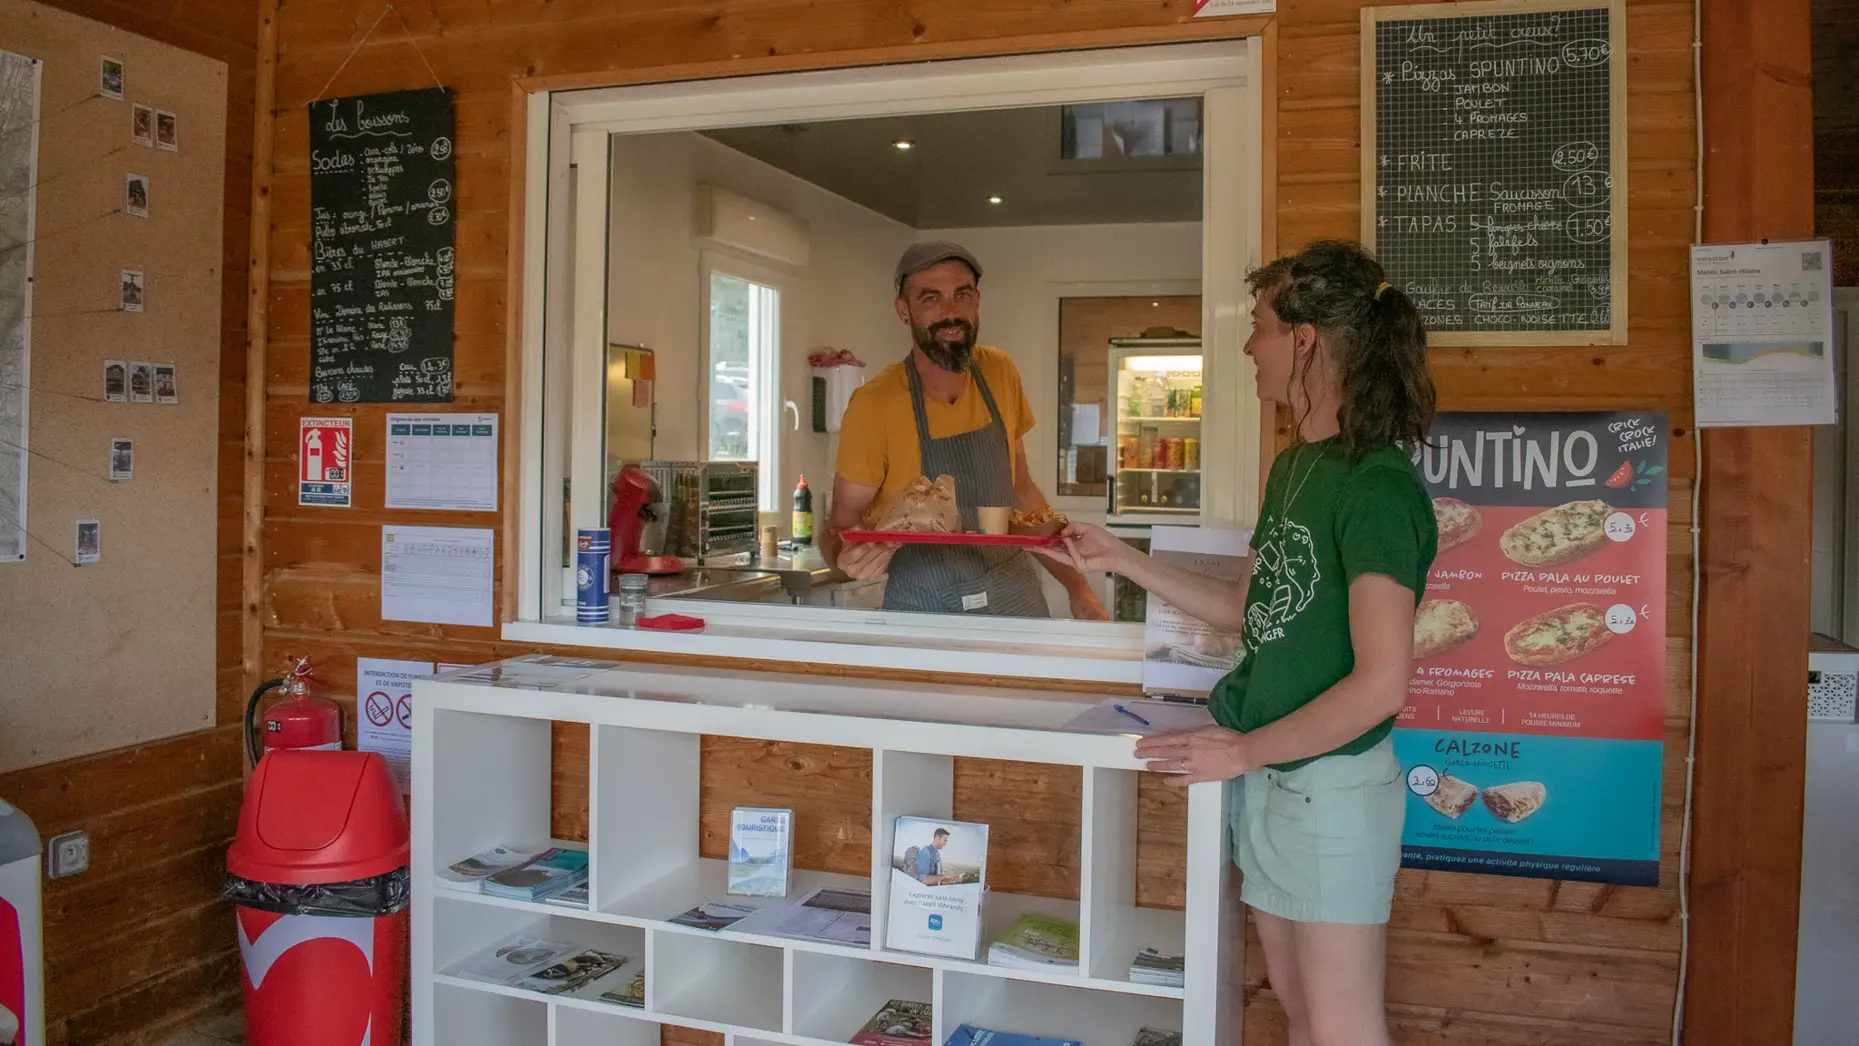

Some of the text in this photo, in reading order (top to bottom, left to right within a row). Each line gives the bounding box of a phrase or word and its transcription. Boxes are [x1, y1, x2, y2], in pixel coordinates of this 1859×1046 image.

[1406, 15, 1561, 64] Un petit creux?
[1402, 60, 1457, 92] Pizzas
[1454, 82, 1511, 95] JAMBON
[1456, 98, 1507, 110] POULET
[1454, 112, 1528, 124] 4 FROMAGES
[1454, 128, 1520, 141] CAPREZE
[312, 150, 355, 171] Sodas
[1397, 183, 1483, 203] PLANCHE
[1489, 182, 1564, 201] Saucisson
[1494, 201, 1555, 213] FROMAGE
[1394, 215, 1457, 233] TAPAS
[1470, 237, 1481, 255] 5
[1471, 255, 1482, 271] 5
[1412, 299, 1456, 311] LACES
[1421, 314, 1463, 325] ZONES
[302, 419, 351, 428] EXTINCTEUR
[1608, 418, 1641, 433] CRICK
[1619, 426, 1656, 442] CROCK
[1618, 436, 1657, 453] ITALIE!
[1411, 425, 1599, 490] UNTINO
[1434, 570, 1482, 580] JAMBON
[1502, 571, 1641, 585] PIZZA PALA AU POULET
[1425, 582, 1451, 591] zzarella
[1523, 584, 1617, 596] Poulet, pesto, mozzarella
[1416, 667, 1495, 680] 4 FROMAGES
[1507, 670, 1637, 686] PIZZA PALA CAPRESE
[391, 681, 412, 689] VAPOTE
[1408, 678, 1483, 691] damer, Gorgonzola
[1516, 682, 1624, 696] Mozzarella, tomate, roquette
[1422, 688, 1455, 697] Romano
[1459, 708, 1485, 717] LEVURE
[1537, 712, 1564, 721] HEURES
[1565, 713, 1576, 721] DE
[1451, 716, 1491, 724] NATURELLE
[1521, 719, 1581, 729] POUSSE MINIMUM
[1434, 739, 1521, 759] CALZONE
[1401, 851, 1601, 873] anté, pratiquez une activité physique régulière
